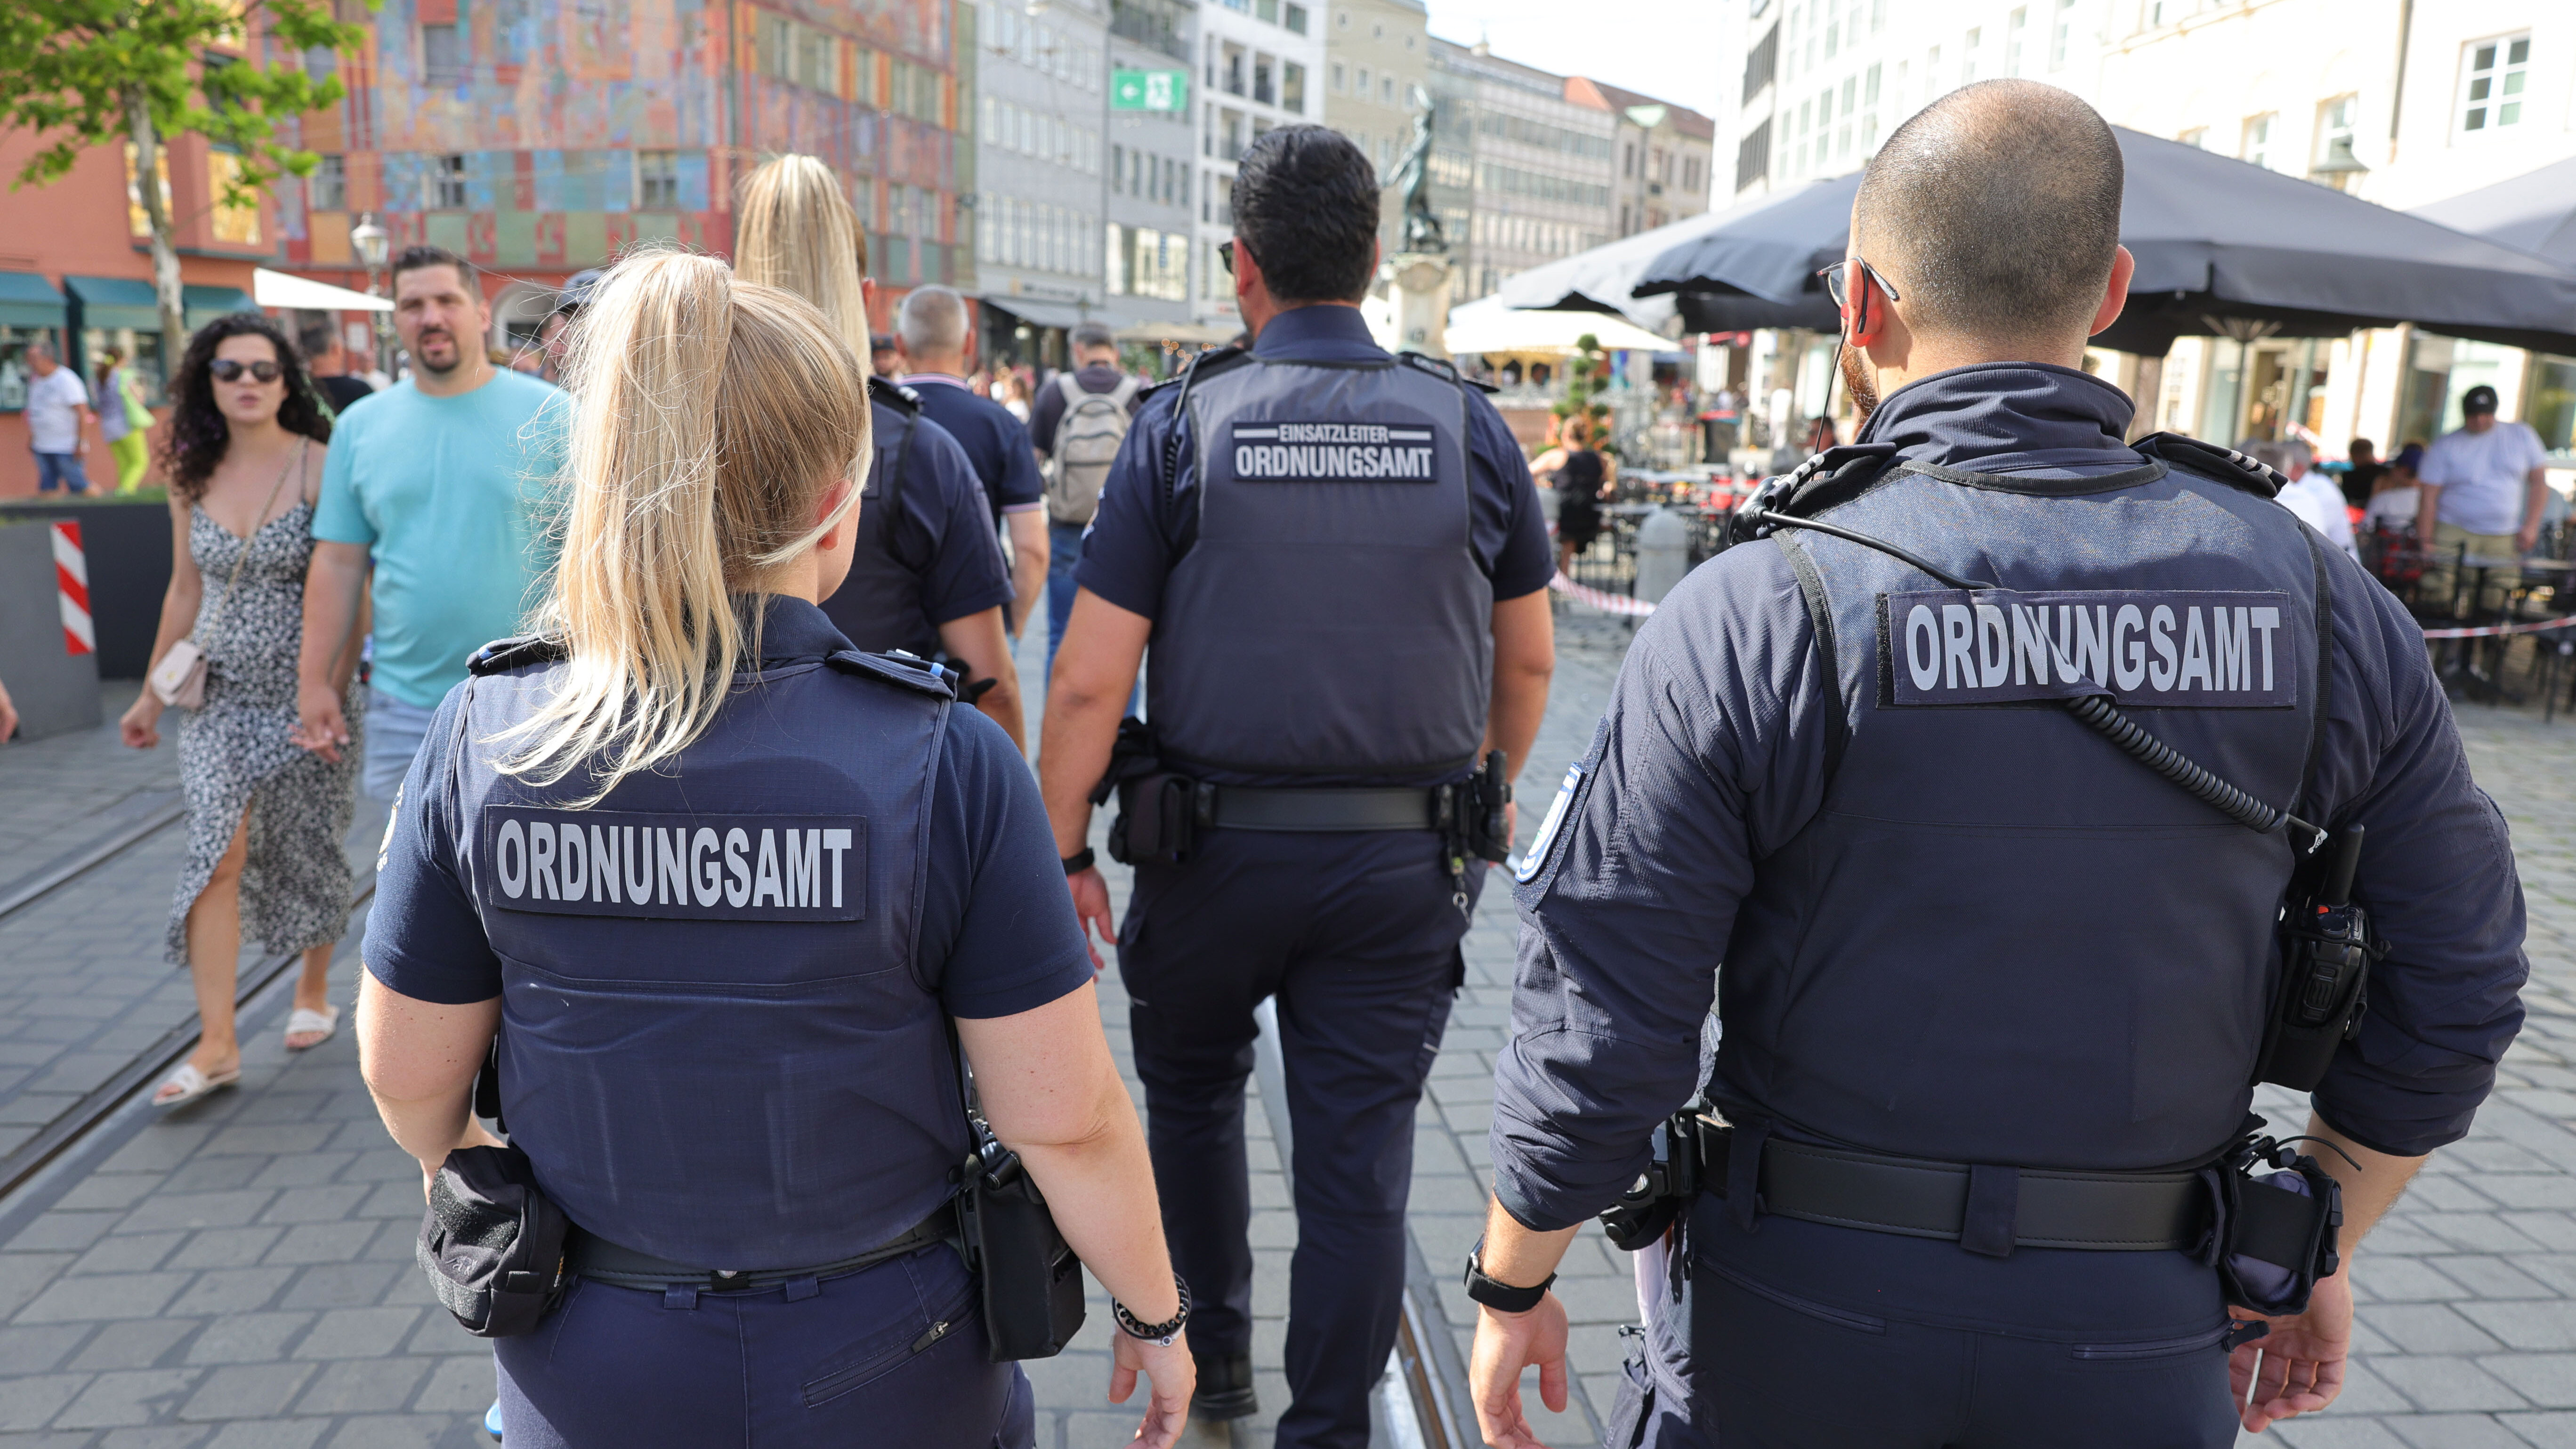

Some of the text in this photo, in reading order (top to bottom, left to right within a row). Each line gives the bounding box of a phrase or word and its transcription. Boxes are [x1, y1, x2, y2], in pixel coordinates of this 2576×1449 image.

[1236, 446, 1432, 477] ORDNUNGSAMT
[1279, 424, 1389, 443] EINSATZLEITER
[1906, 604, 2280, 691] ORDNUNGSAMT
[497, 819, 852, 907] ORDNUNGSAMT
